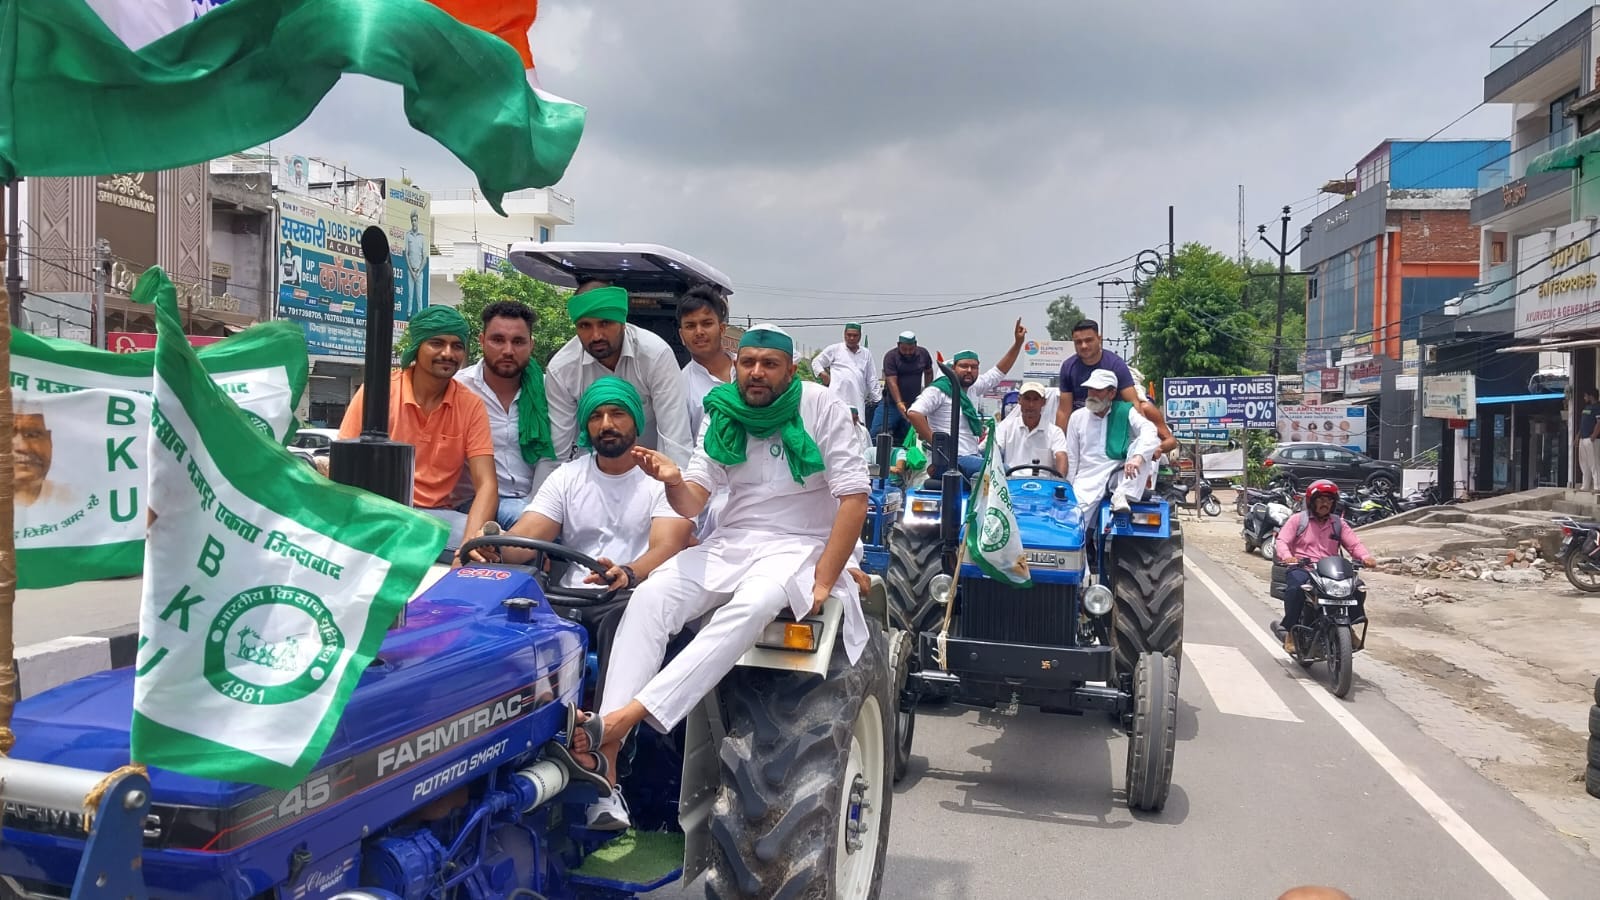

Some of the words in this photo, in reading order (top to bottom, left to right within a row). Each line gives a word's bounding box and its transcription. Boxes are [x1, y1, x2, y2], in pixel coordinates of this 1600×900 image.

[281, 216, 326, 248] सरकारी
[326, 220, 348, 241] JOBS
[329, 242, 365, 256] ACADE
[305, 259, 315, 271] UP
[303, 273, 319, 284] DELHI
[1538, 272, 1598, 298] ENTERPRISES
[1167, 384, 1211, 396] GUPTA
[1214, 383, 1226, 395] JI
[1230, 382, 1273, 394] FONES
[106, 396, 139, 523] BKU
[60, 509, 85, 529] अमर
[214, 501, 264, 544] एकता
[263, 529, 345, 581] जिन्दाबाद
[217, 589, 265, 629] भारतीय
[270, 586, 326, 616] किसान
[221, 679, 266, 704] 4981
[377, 694, 523, 777] FARMTRAC
[412, 759, 469, 801] POTATO
[468, 738, 510, 771] SMART
[278, 774, 331, 818] 45
[306, 863, 343, 891] Classic
[320, 873, 344, 893] SMART
